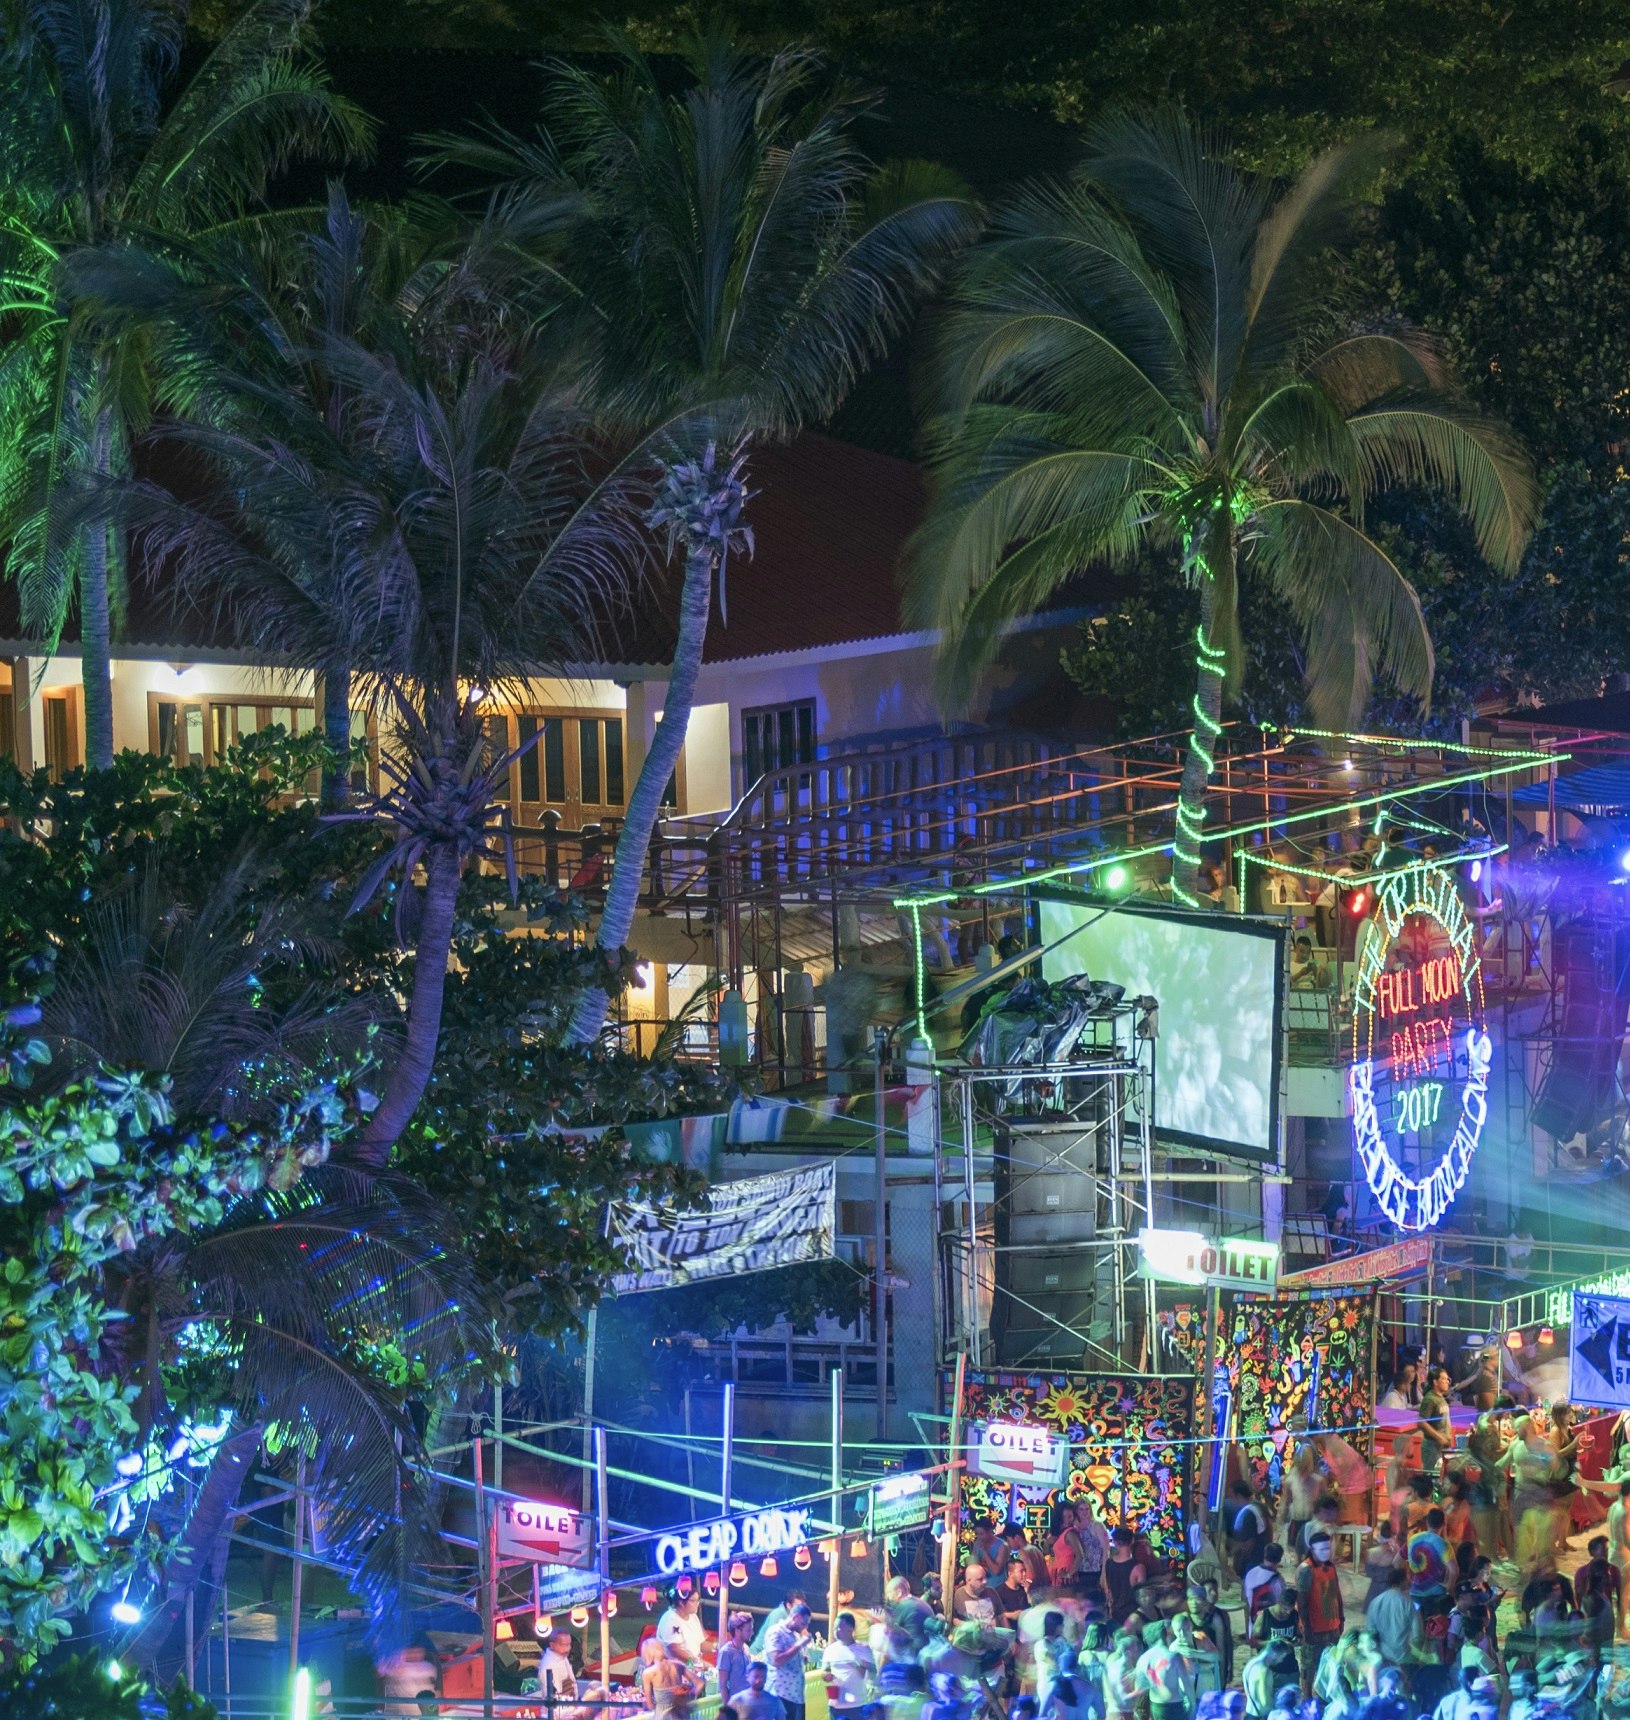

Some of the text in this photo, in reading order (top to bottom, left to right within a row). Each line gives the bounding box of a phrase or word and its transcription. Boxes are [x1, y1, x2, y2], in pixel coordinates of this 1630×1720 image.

[1380, 955, 1460, 1017] FULL MOON
[1392, 1016, 1453, 1081] PARTY
[1397, 1083, 1443, 1134] 2017
[1615, 1367, 1624, 1385] 5
[974, 1427, 1060, 1456] TOILET
[503, 1501, 585, 1537] TOILET
[656, 1520, 738, 1574] CHEAP
